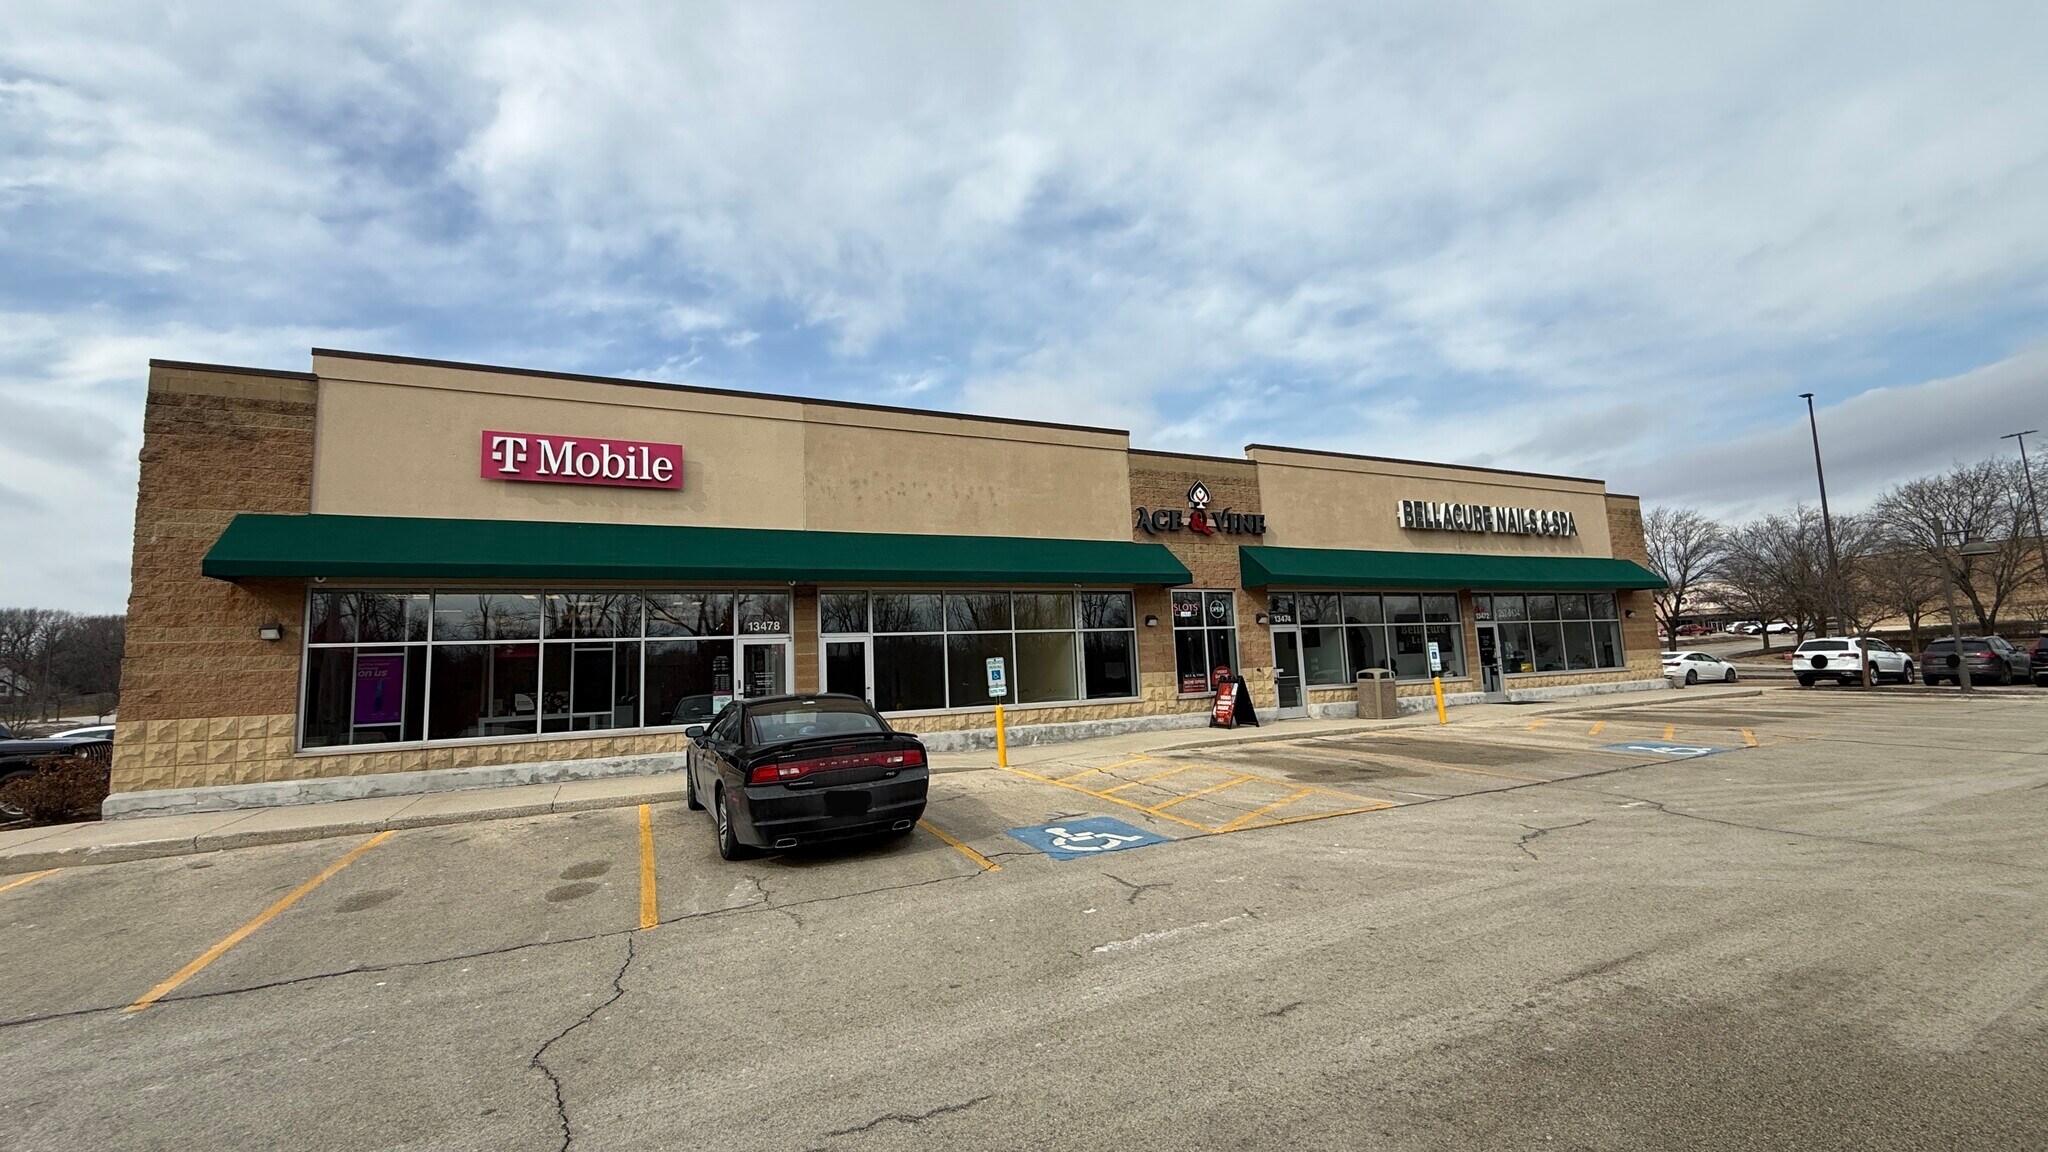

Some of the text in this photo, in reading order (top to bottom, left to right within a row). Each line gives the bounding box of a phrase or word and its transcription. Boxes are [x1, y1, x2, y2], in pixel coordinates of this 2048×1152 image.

[492, 436, 673, 482] T Mobile
[1136, 507, 1182, 534] ACE
[1211, 507, 1265, 533] VINE
[1398, 500, 1577, 536] BELLACURE NAILS & SPA
[1173, 603, 1198, 611] SLOTS
[749, 621, 780, 631] 13478
